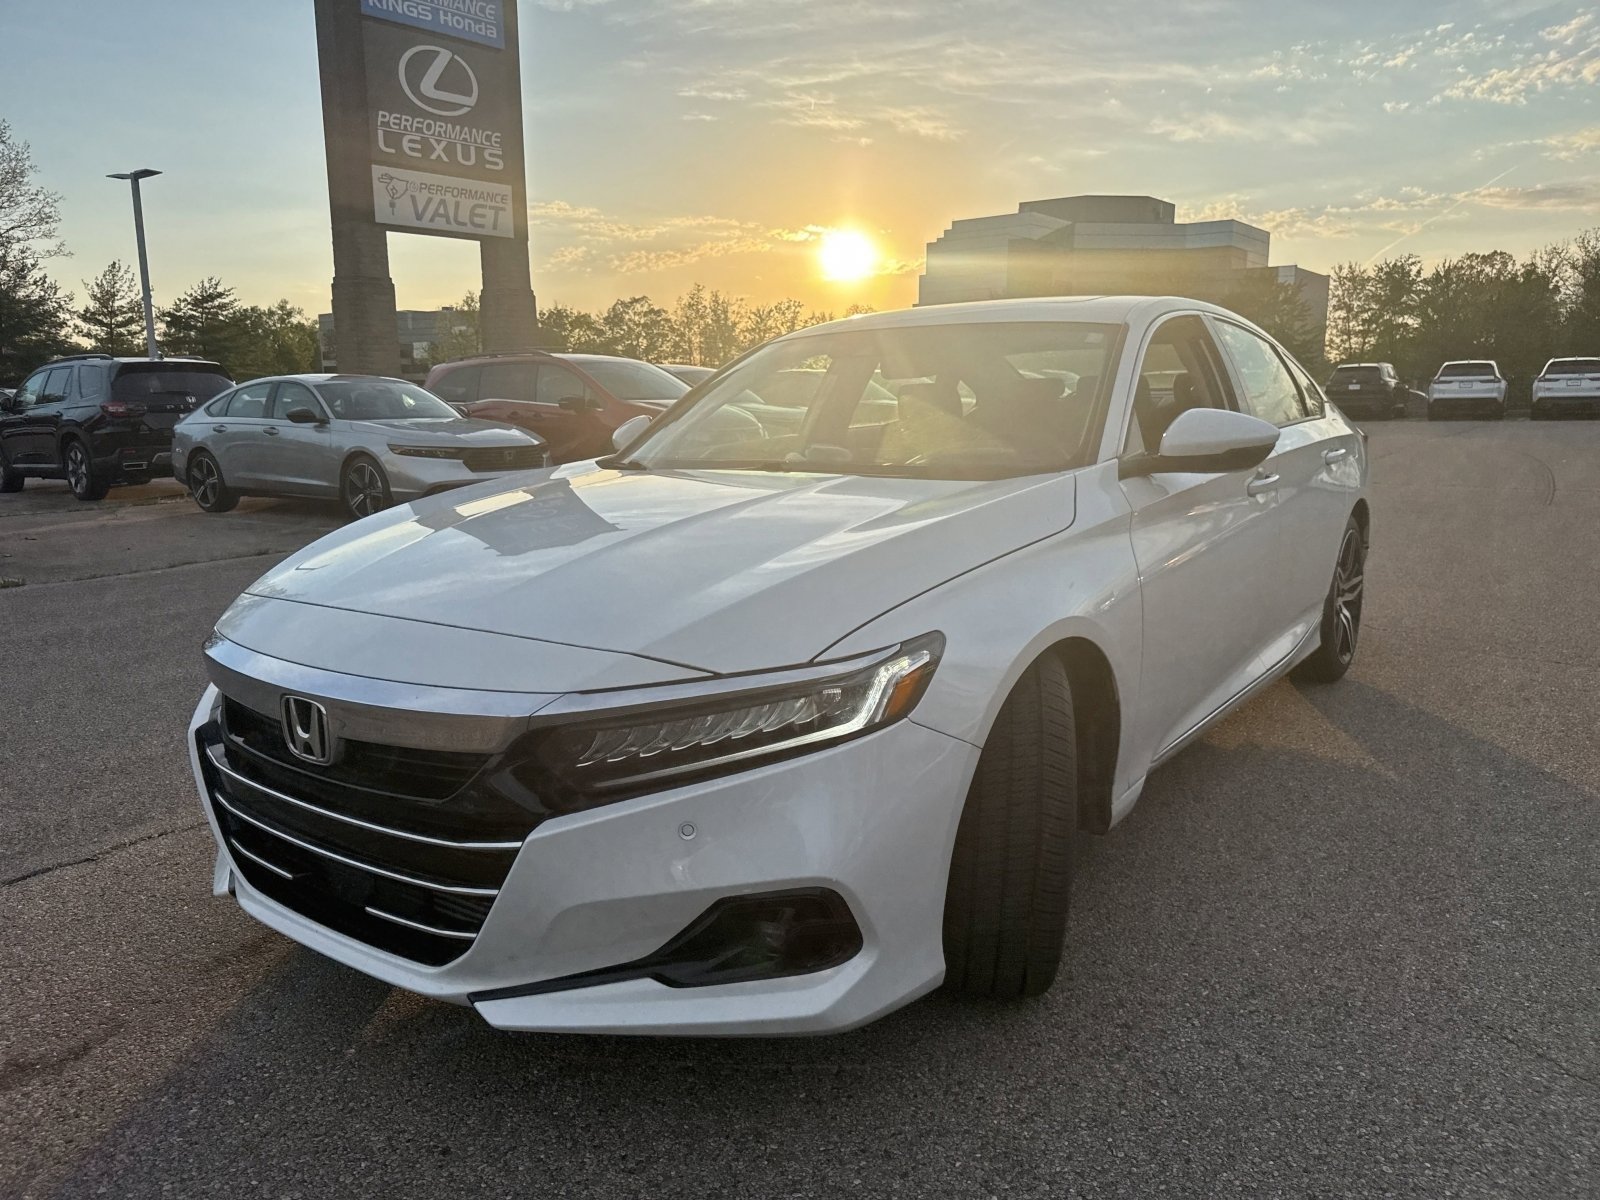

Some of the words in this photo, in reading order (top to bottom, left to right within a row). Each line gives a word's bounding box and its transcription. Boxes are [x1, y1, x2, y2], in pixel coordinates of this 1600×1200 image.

[439, 10, 498, 38] Honda
[377, 110, 502, 147] PERFORMANCE
[377, 130, 504, 171] LEXUS
[419, 182, 508, 205] PERFORMANCE
[410, 194, 507, 231] VALET
